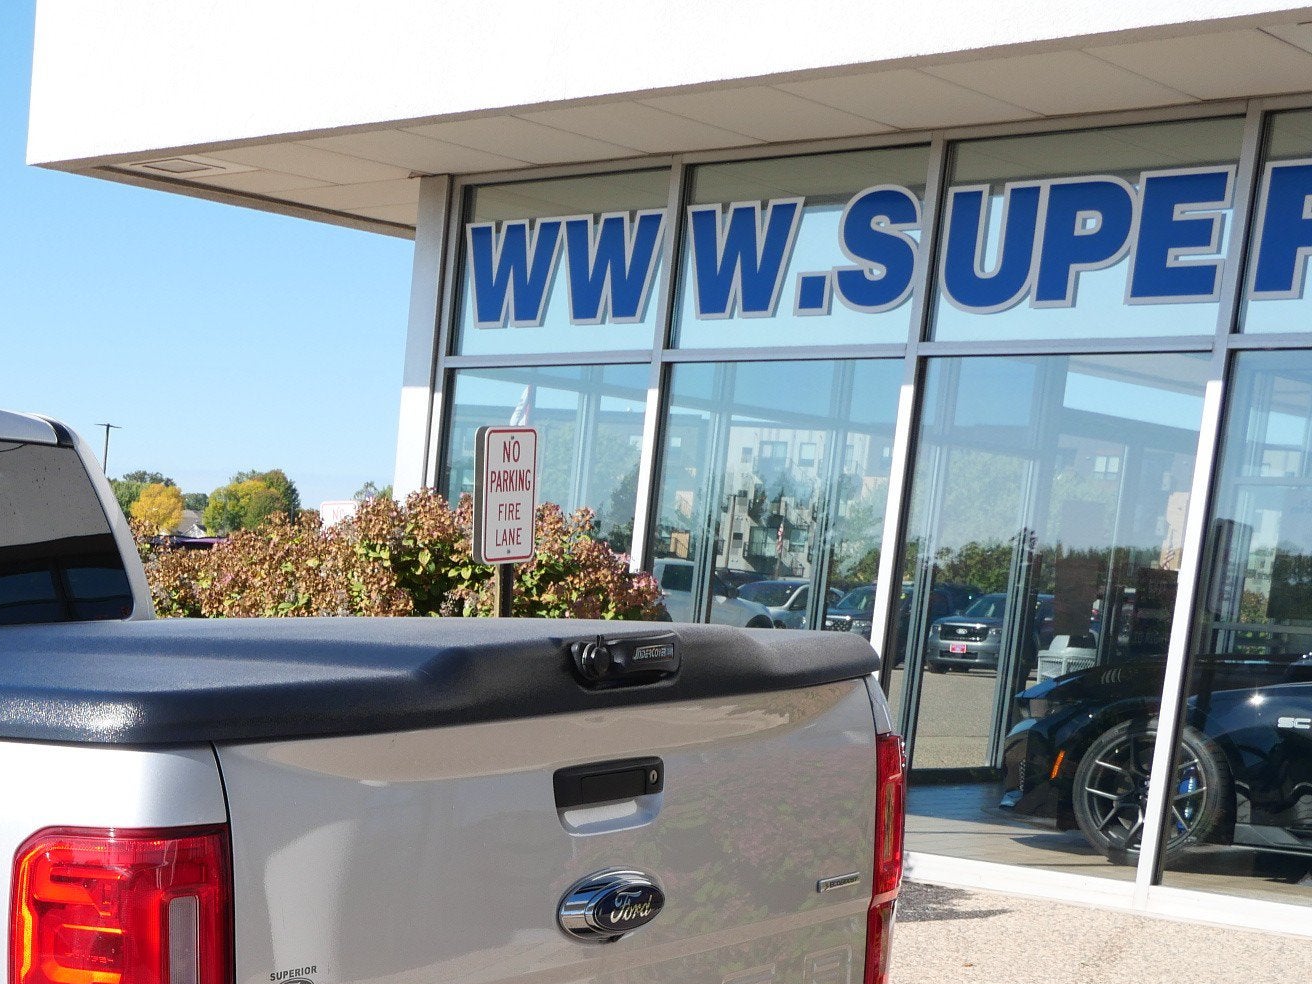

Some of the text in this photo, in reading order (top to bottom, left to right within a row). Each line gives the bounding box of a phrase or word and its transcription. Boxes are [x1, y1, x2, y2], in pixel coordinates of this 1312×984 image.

[502, 440, 521, 463] NO
[490, 469, 531, 493] PARKING
[498, 502, 522, 521] FIRE
[495, 527, 523, 547] LANE
[610, 890, 653, 924] Ford
[270, 965, 318, 981] SUPERIOR
